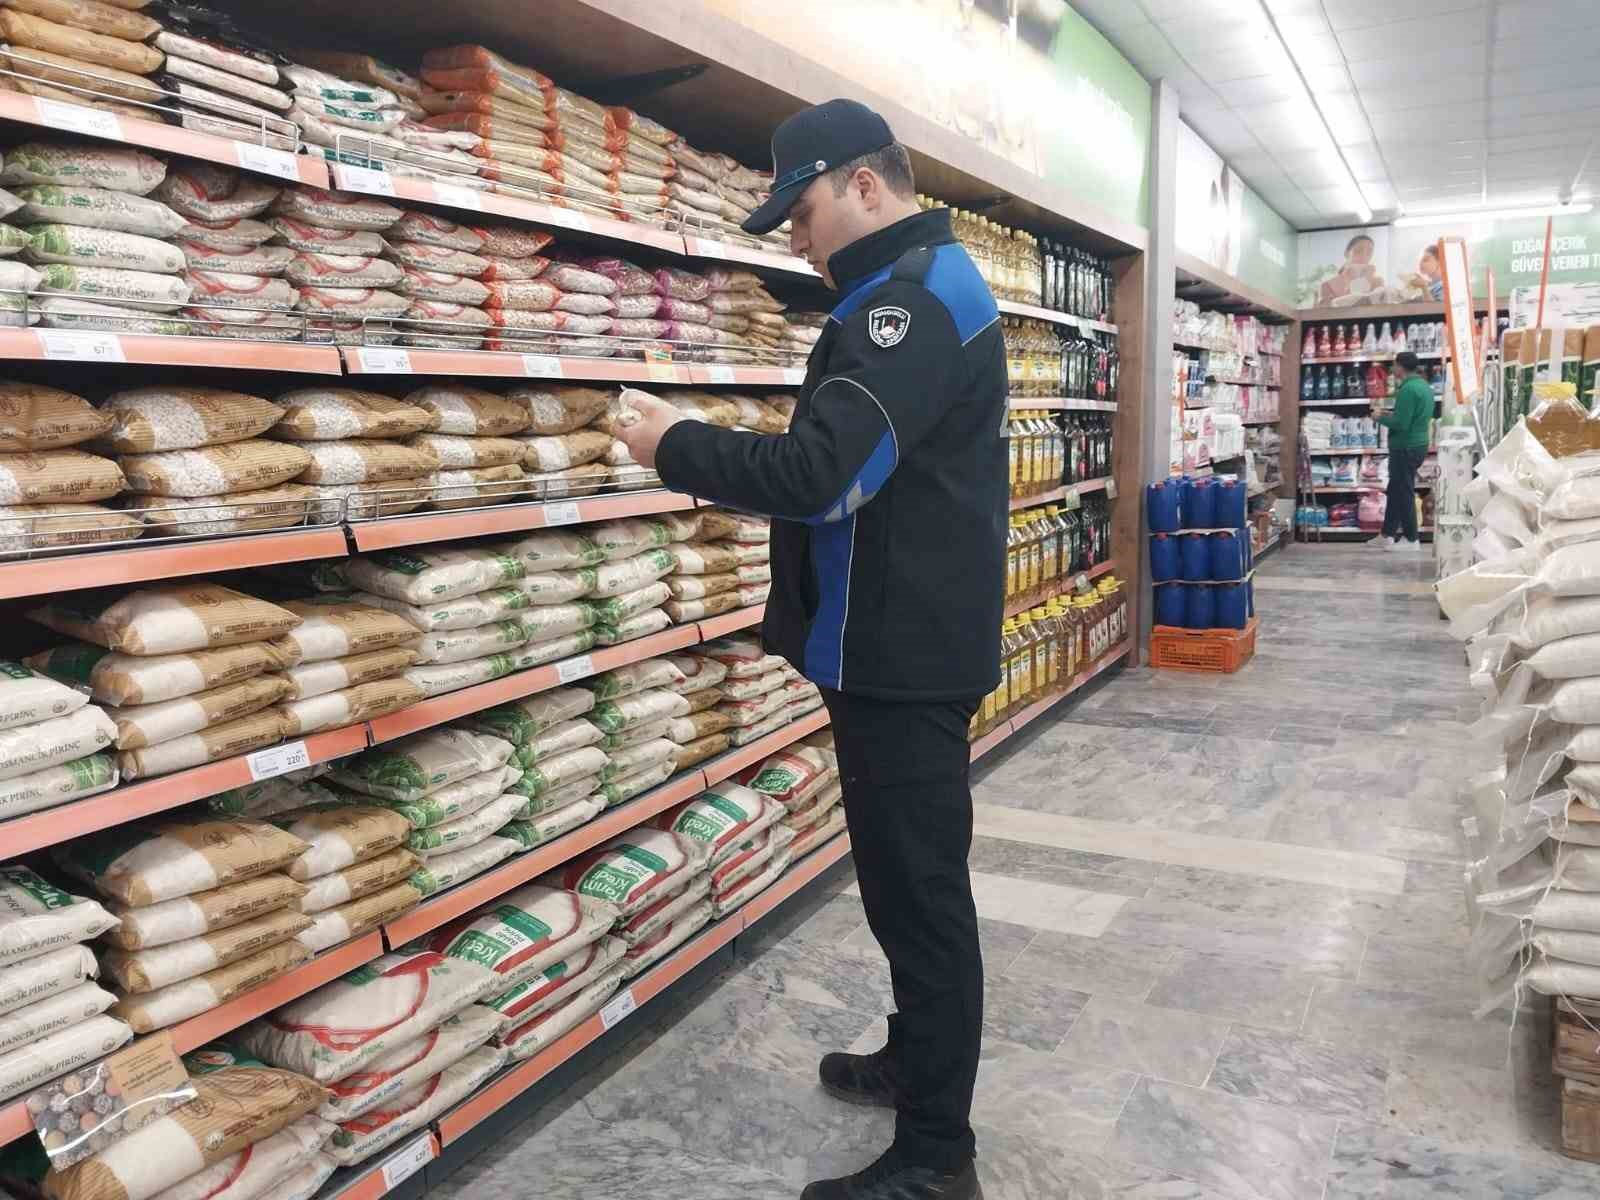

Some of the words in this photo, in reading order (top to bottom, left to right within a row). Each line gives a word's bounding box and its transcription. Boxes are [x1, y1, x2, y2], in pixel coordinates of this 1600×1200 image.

[1512, 237, 1543, 254] DOĞA
[1511, 254, 1545, 273] GÜVE
[592, 869, 630, 890] Kredi
